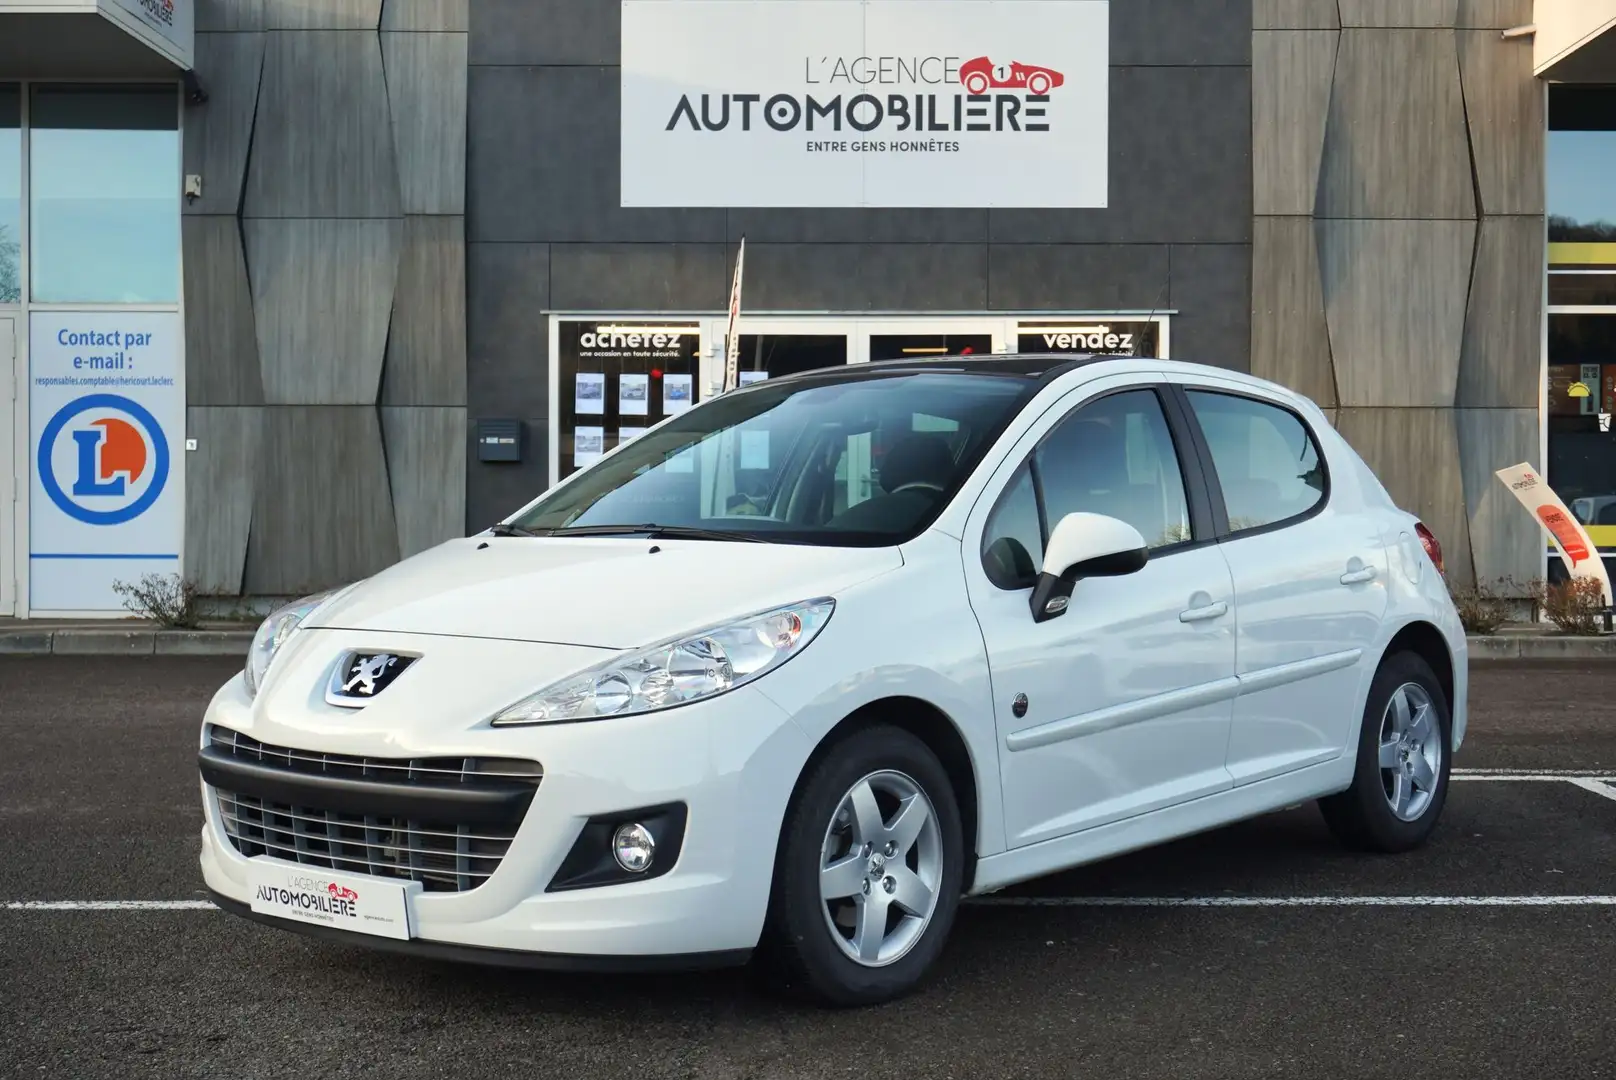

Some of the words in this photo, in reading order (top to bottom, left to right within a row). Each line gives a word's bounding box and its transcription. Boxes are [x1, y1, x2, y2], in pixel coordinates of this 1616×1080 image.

[805, 56, 960, 84] L'AGENCE
[997, 66, 1005, 79] 1
[806, 141, 847, 153] ENTRE
[851, 141, 886, 153] GENS
[890, 137, 960, 153] HONNÊTES
[57, 329, 120, 346] Contact
[124, 332, 152, 350] par
[580, 325, 681, 348] achetez
[1043, 325, 1133, 349] vendez
[73, 352, 124, 370] e-mail
[593, 349, 622, 358] occasion
[633, 350, 651, 358] toute
